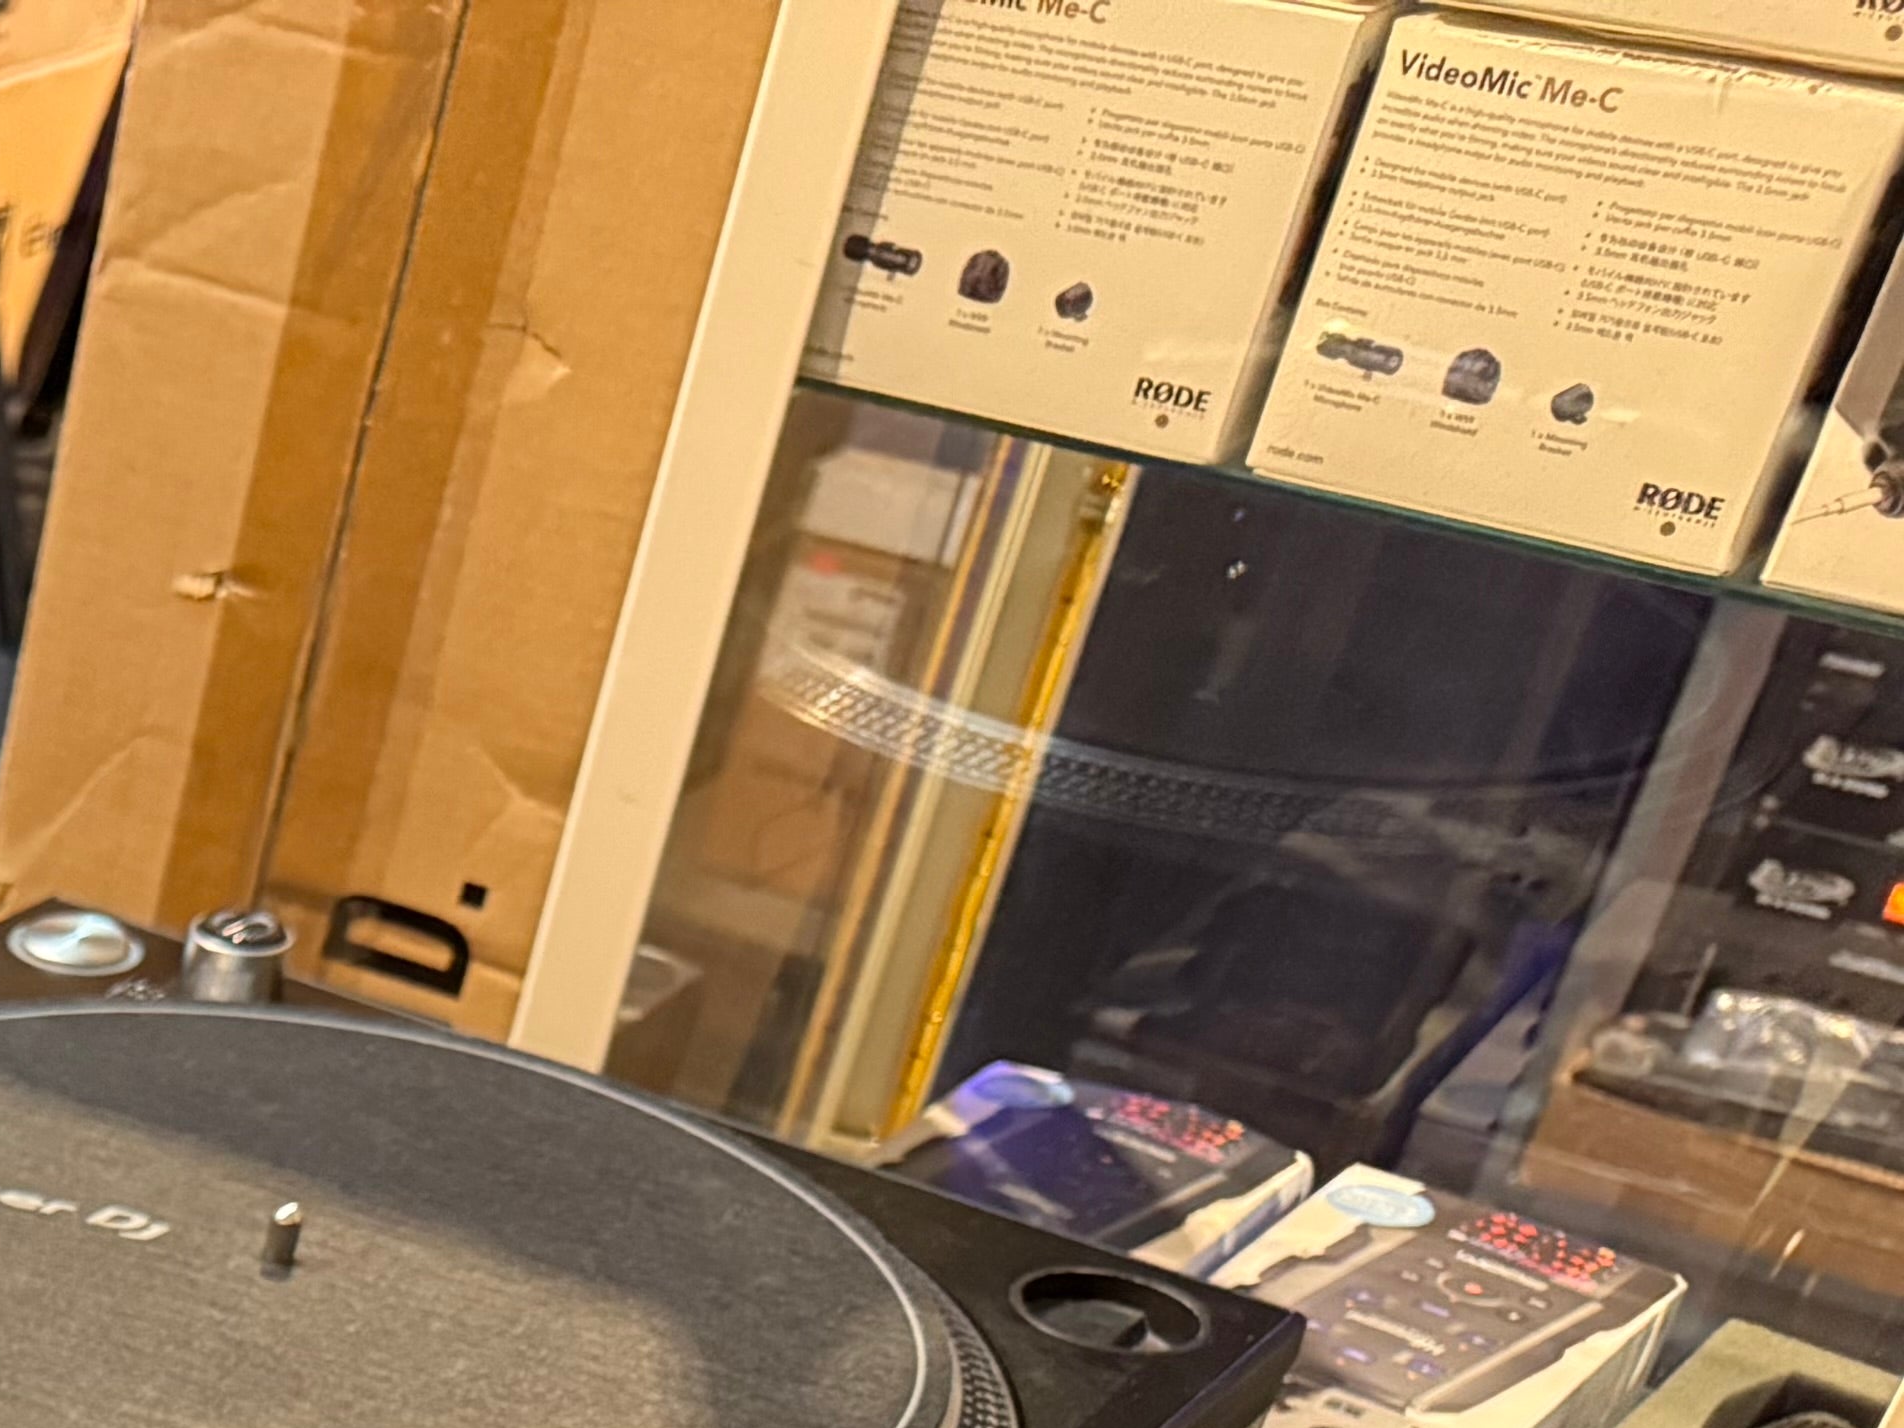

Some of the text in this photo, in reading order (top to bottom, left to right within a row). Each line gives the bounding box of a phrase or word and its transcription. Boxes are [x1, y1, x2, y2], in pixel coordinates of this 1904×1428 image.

[1401, 50, 1624, 114] VideoMic Me-C
[1133, 376, 1212, 413] RØDE
[1637, 483, 1725, 520] RØDE
